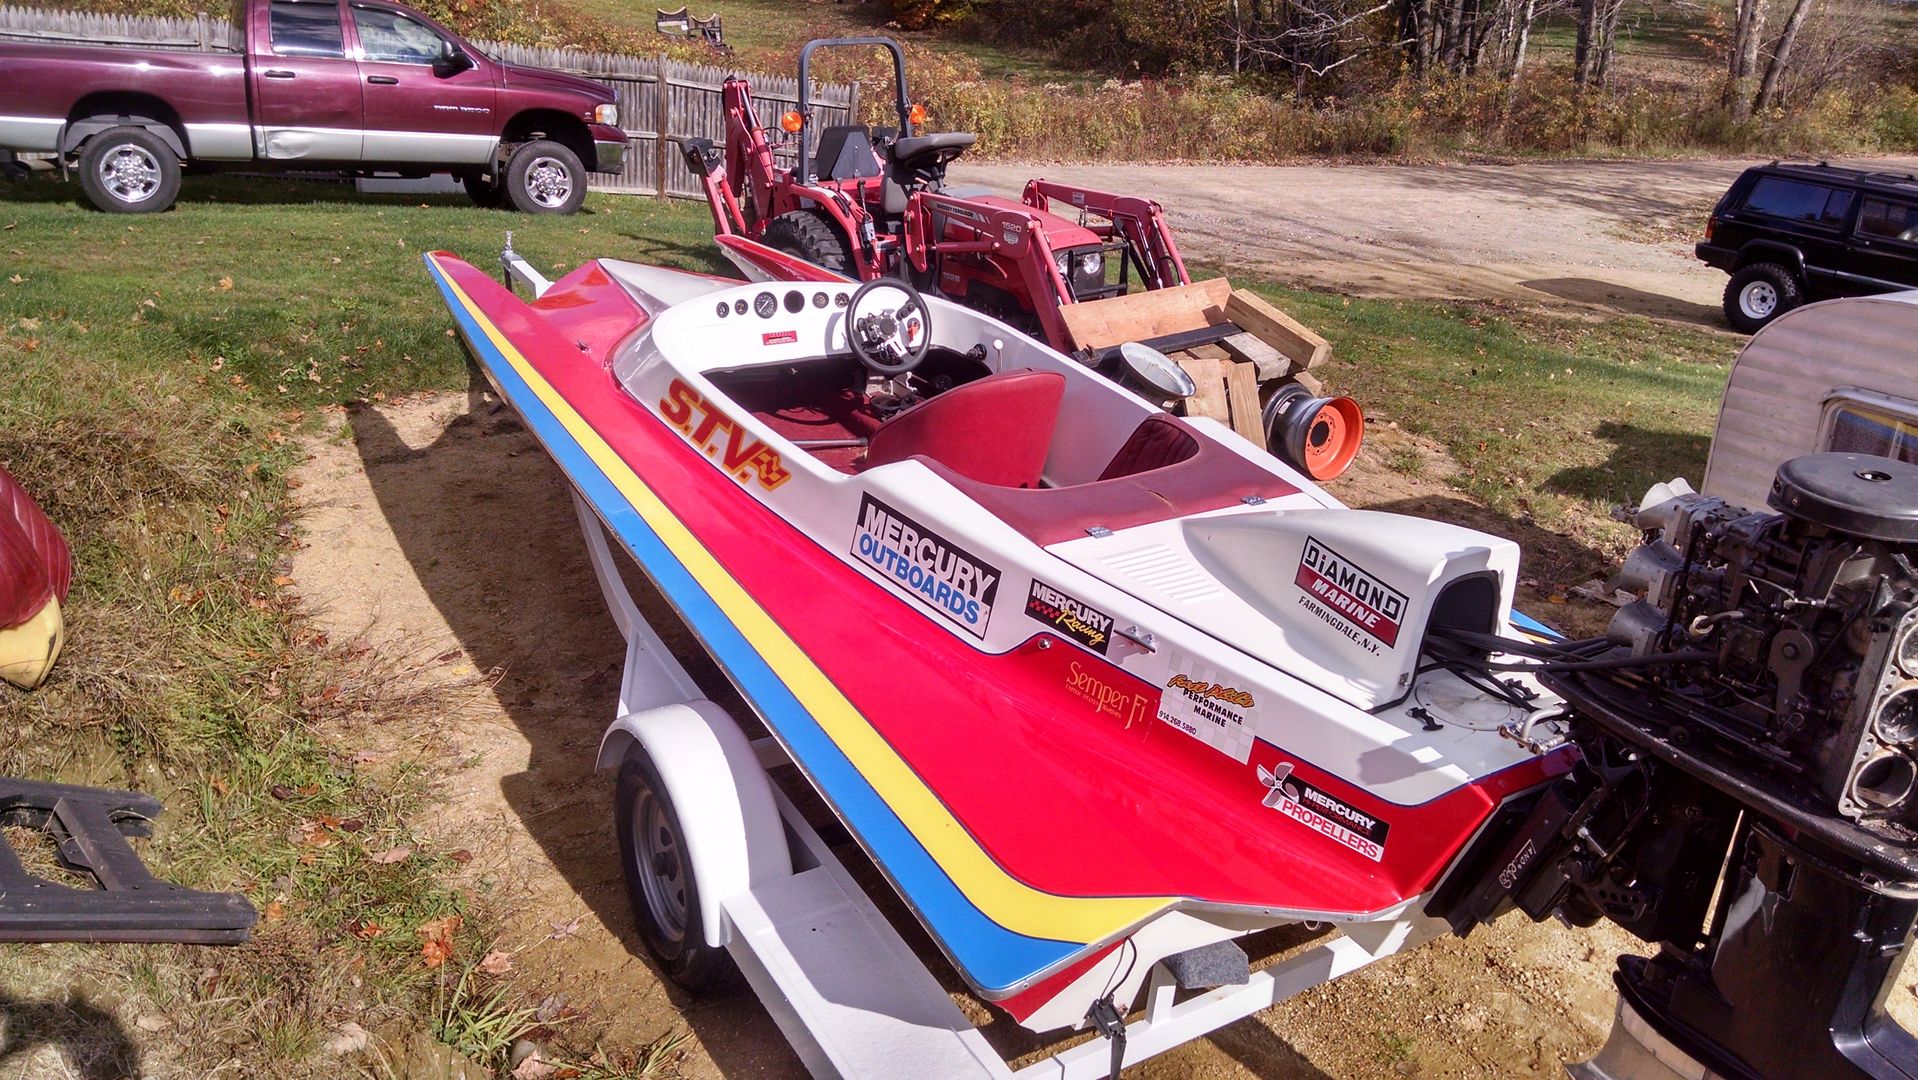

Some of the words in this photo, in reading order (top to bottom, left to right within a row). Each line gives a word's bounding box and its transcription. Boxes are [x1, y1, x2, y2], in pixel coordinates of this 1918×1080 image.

[1001, 221, 1022, 233] 1520
[863, 502, 996, 600] MERCURY
[858, 533, 980, 625] OUTBOARDS
[1311, 578, 1382, 628] MARINE
[1031, 581, 1112, 633] MERCURY
[1055, 609, 1106, 645] Racing
[1066, 661, 1130, 713] Semper
[1124, 693, 1149, 730] Fi
[1182, 687, 1244, 726] PERFORMANCE
[1193, 704, 1227, 728] MARINE
[1281, 799, 1379, 858] PROPELLERS
[1303, 787, 1377, 830] MERCURY
